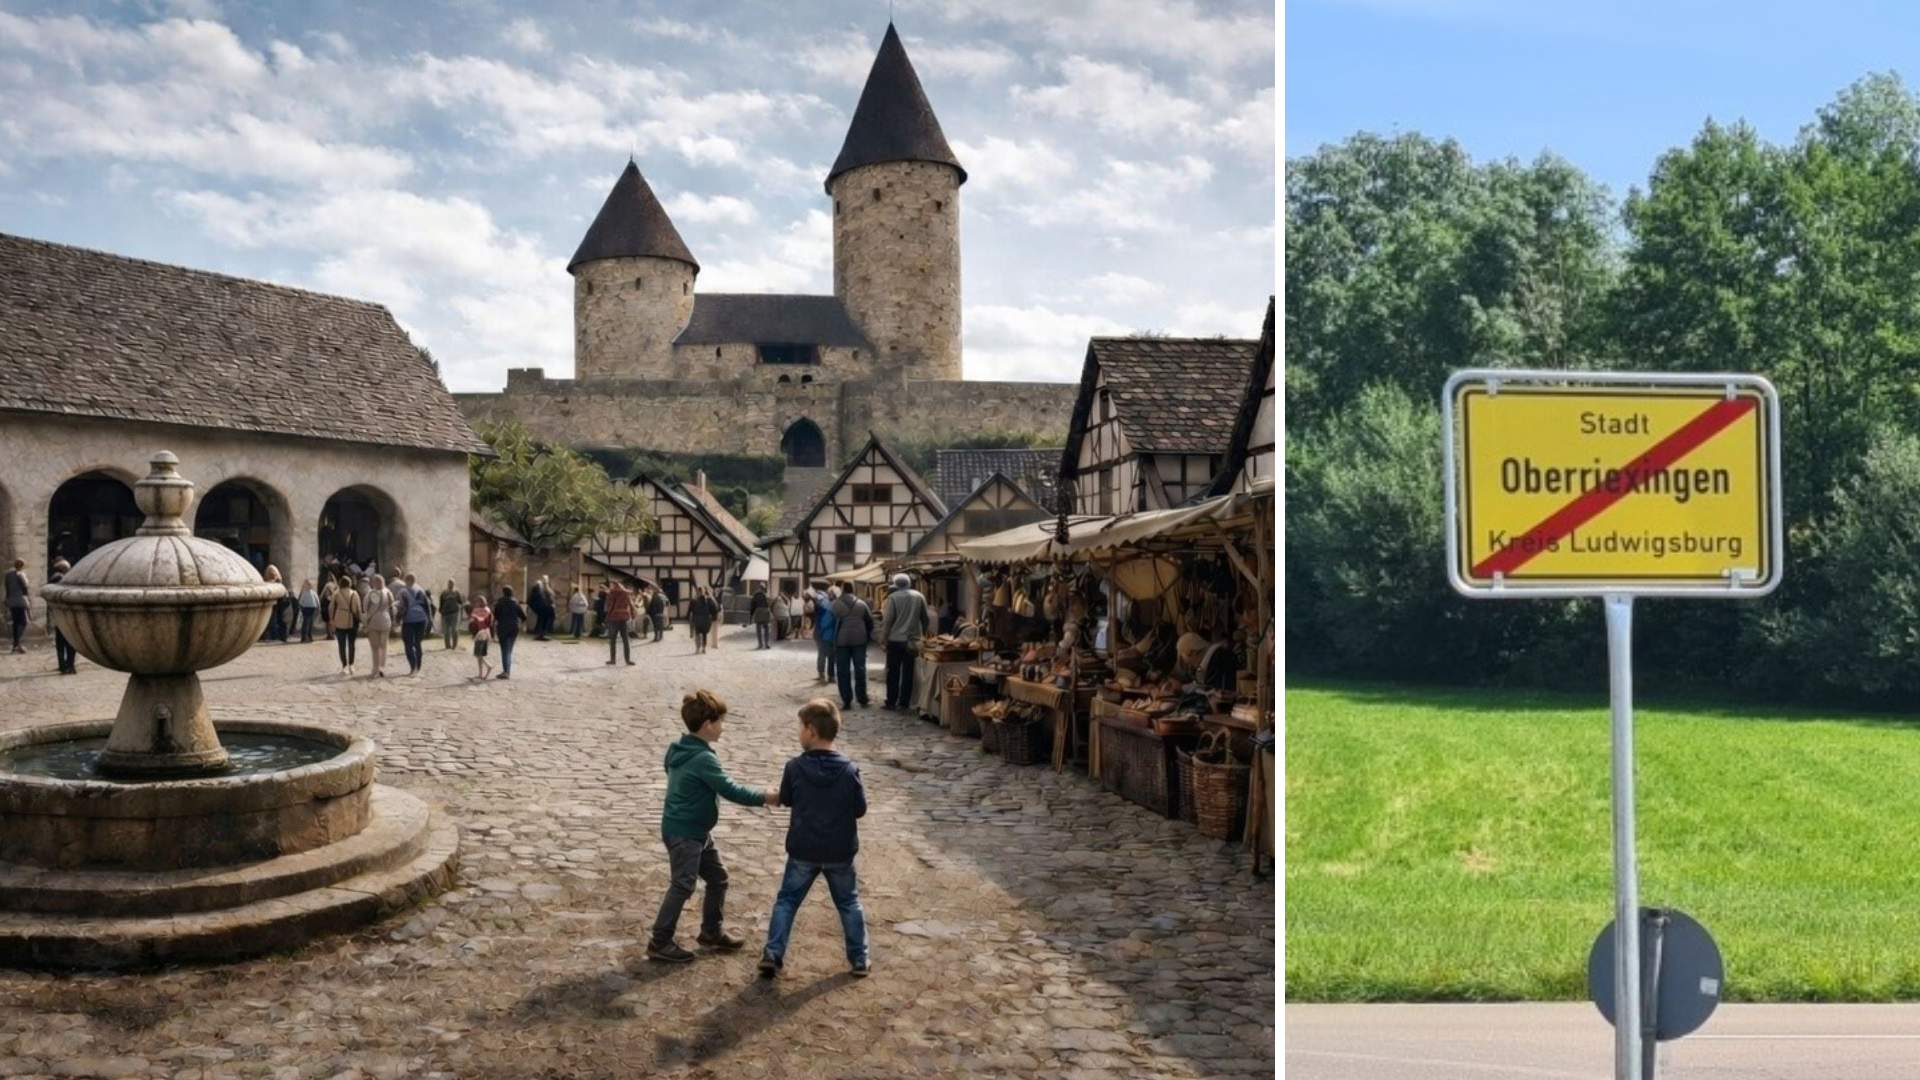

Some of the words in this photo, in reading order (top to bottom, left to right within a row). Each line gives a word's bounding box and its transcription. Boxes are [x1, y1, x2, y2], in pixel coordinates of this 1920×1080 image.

[1580, 412, 1650, 435] Stadt
[1502, 457, 1729, 504] Oberriexingen
[1489, 530, 1560, 553] Kreis
[1570, 530, 1742, 558] Ludwigsburg
